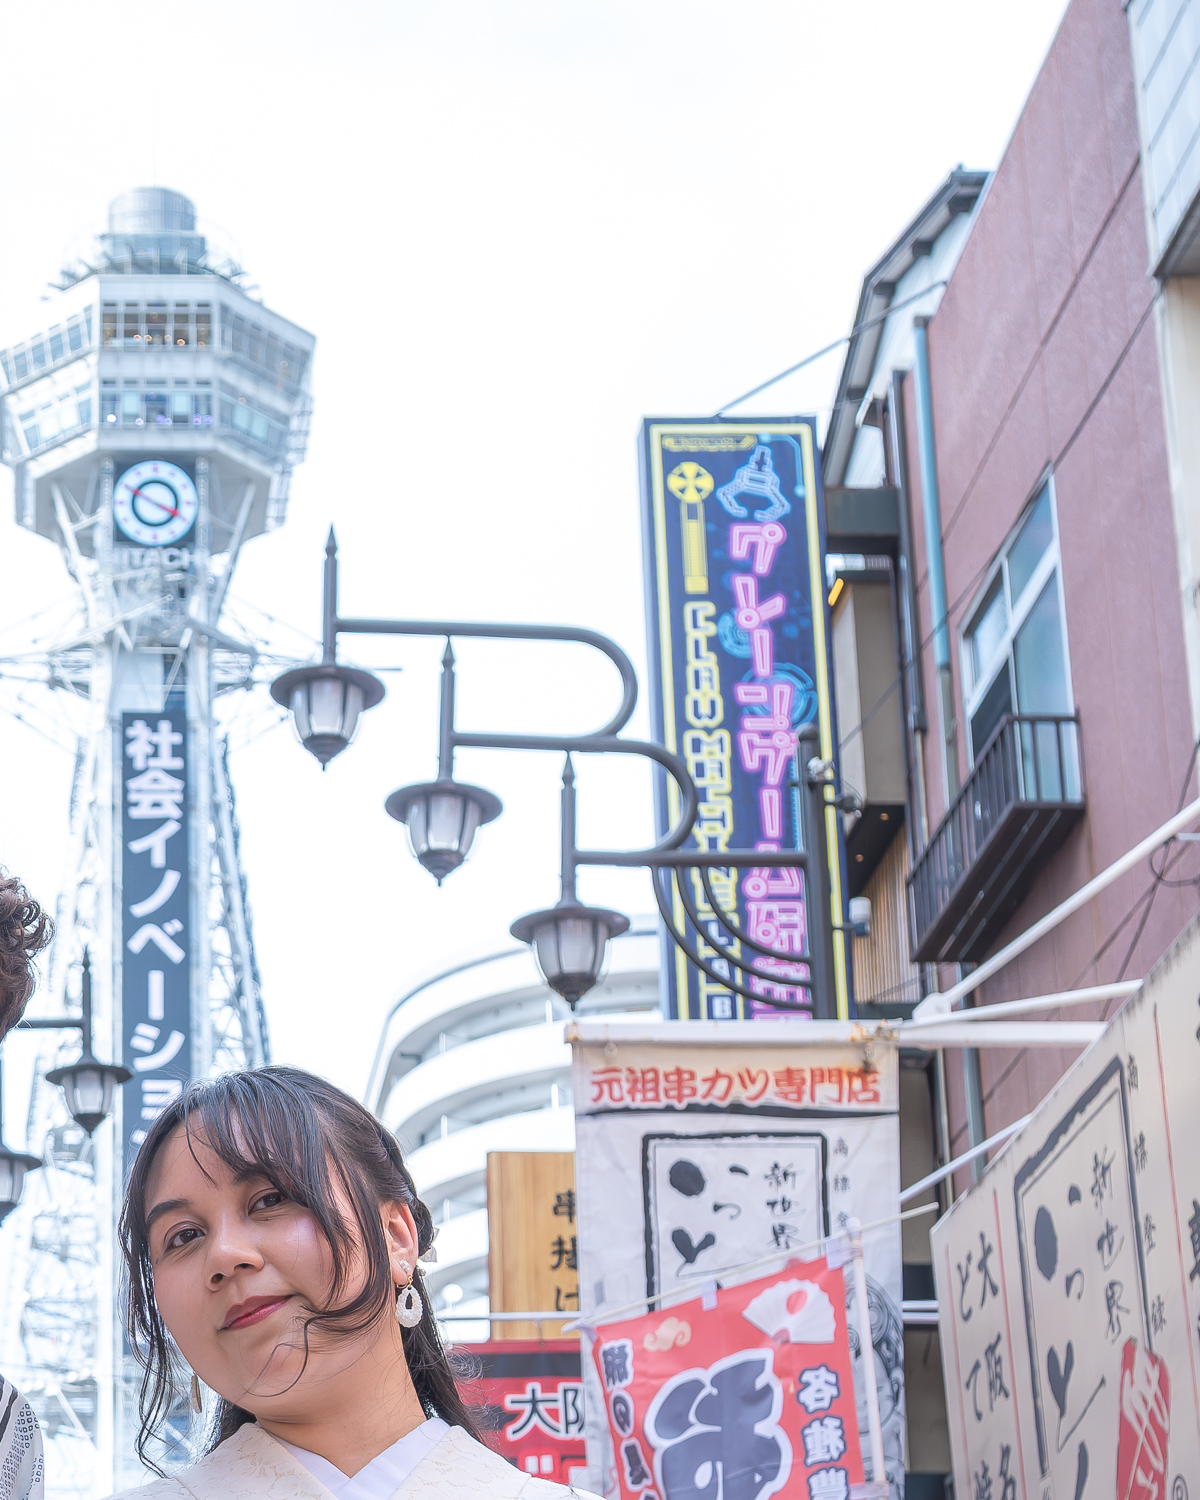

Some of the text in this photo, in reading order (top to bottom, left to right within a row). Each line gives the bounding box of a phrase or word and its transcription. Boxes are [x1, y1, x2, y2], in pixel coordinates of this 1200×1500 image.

[684, 600, 724, 728] CLAW
[127, 718, 187, 1146] 社会イノベーショ
[590, 1065, 882, 1108] 元祖串カツ専門店
[764, 1158, 808, 1250] 新世界
[1090, 1145, 1131, 1344] 新世界
